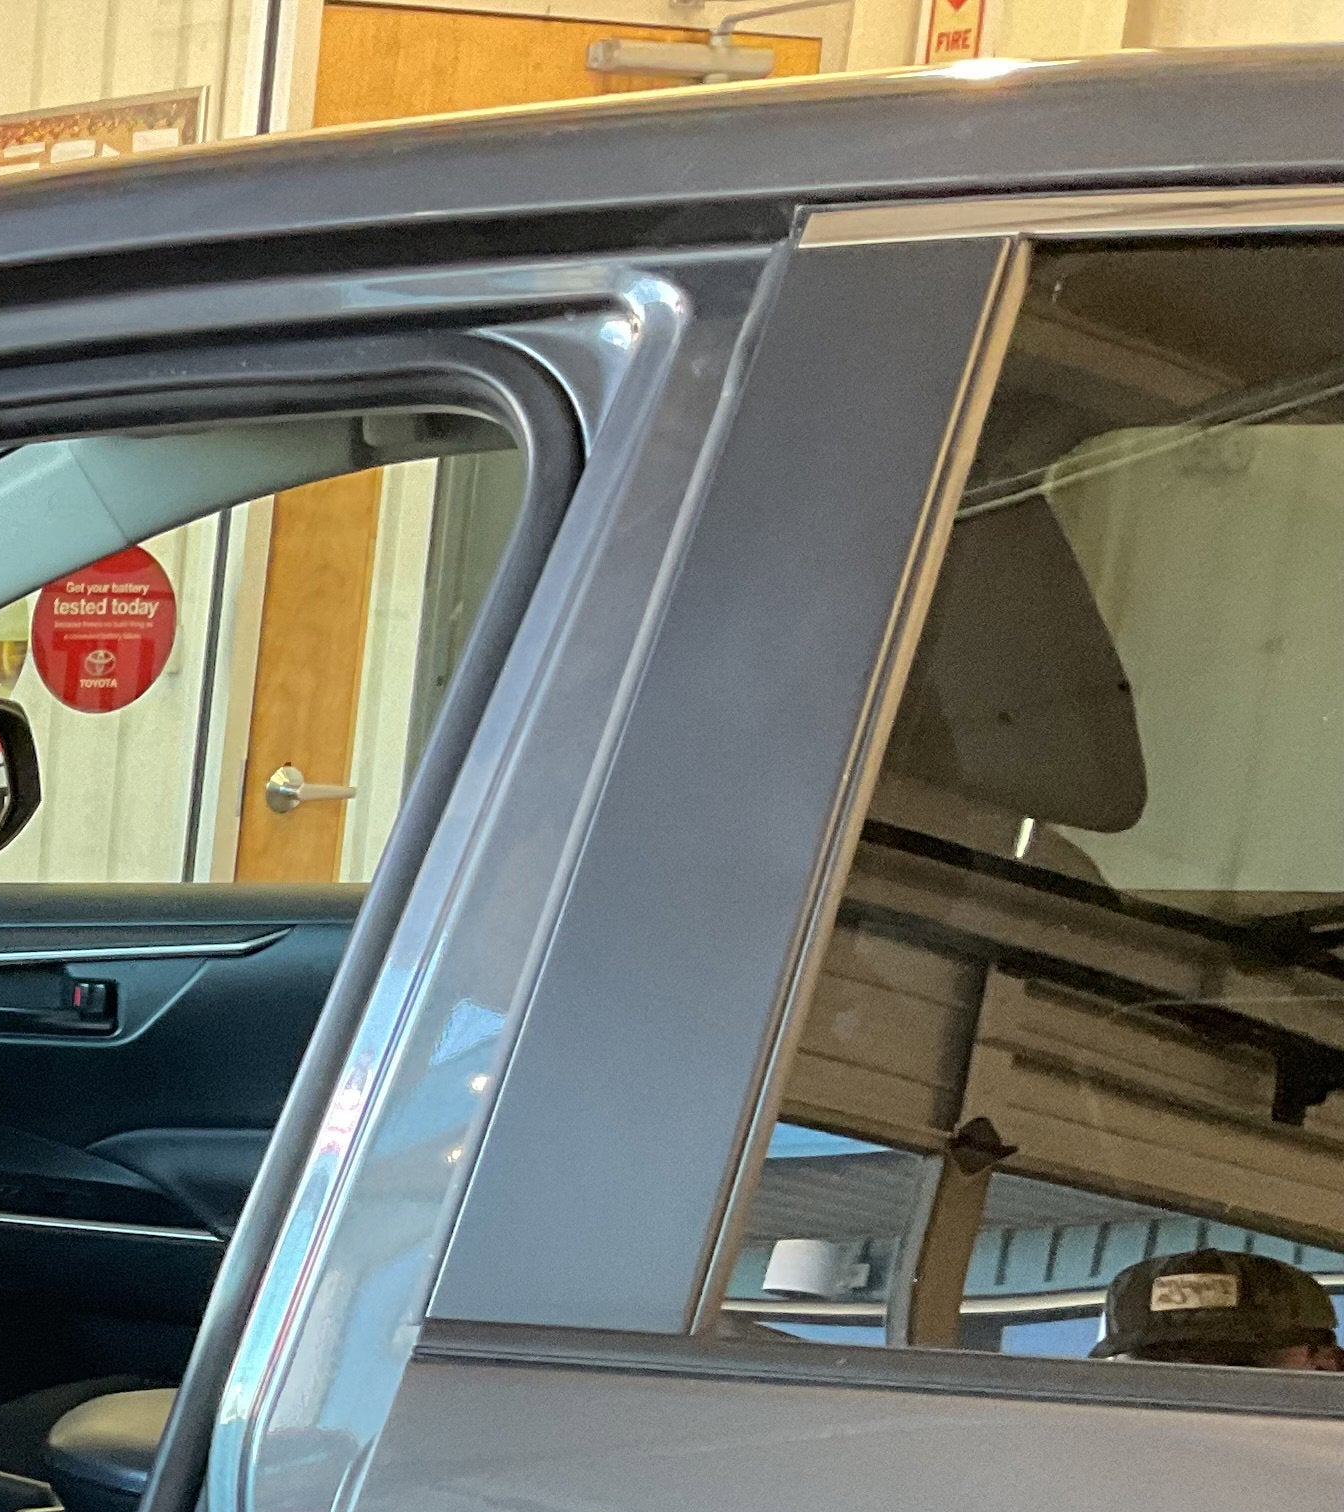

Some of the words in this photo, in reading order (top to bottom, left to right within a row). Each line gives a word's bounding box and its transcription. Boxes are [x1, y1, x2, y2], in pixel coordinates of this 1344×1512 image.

[936, 28, 972, 52] FIRE
[66, 582, 85, 593] Get
[87, 583, 109, 595] your
[112, 582, 150, 595] battery
[53, 597, 107, 615] tested
[112, 598, 159, 618] today
[79, 678, 117, 688] TOYOTA
